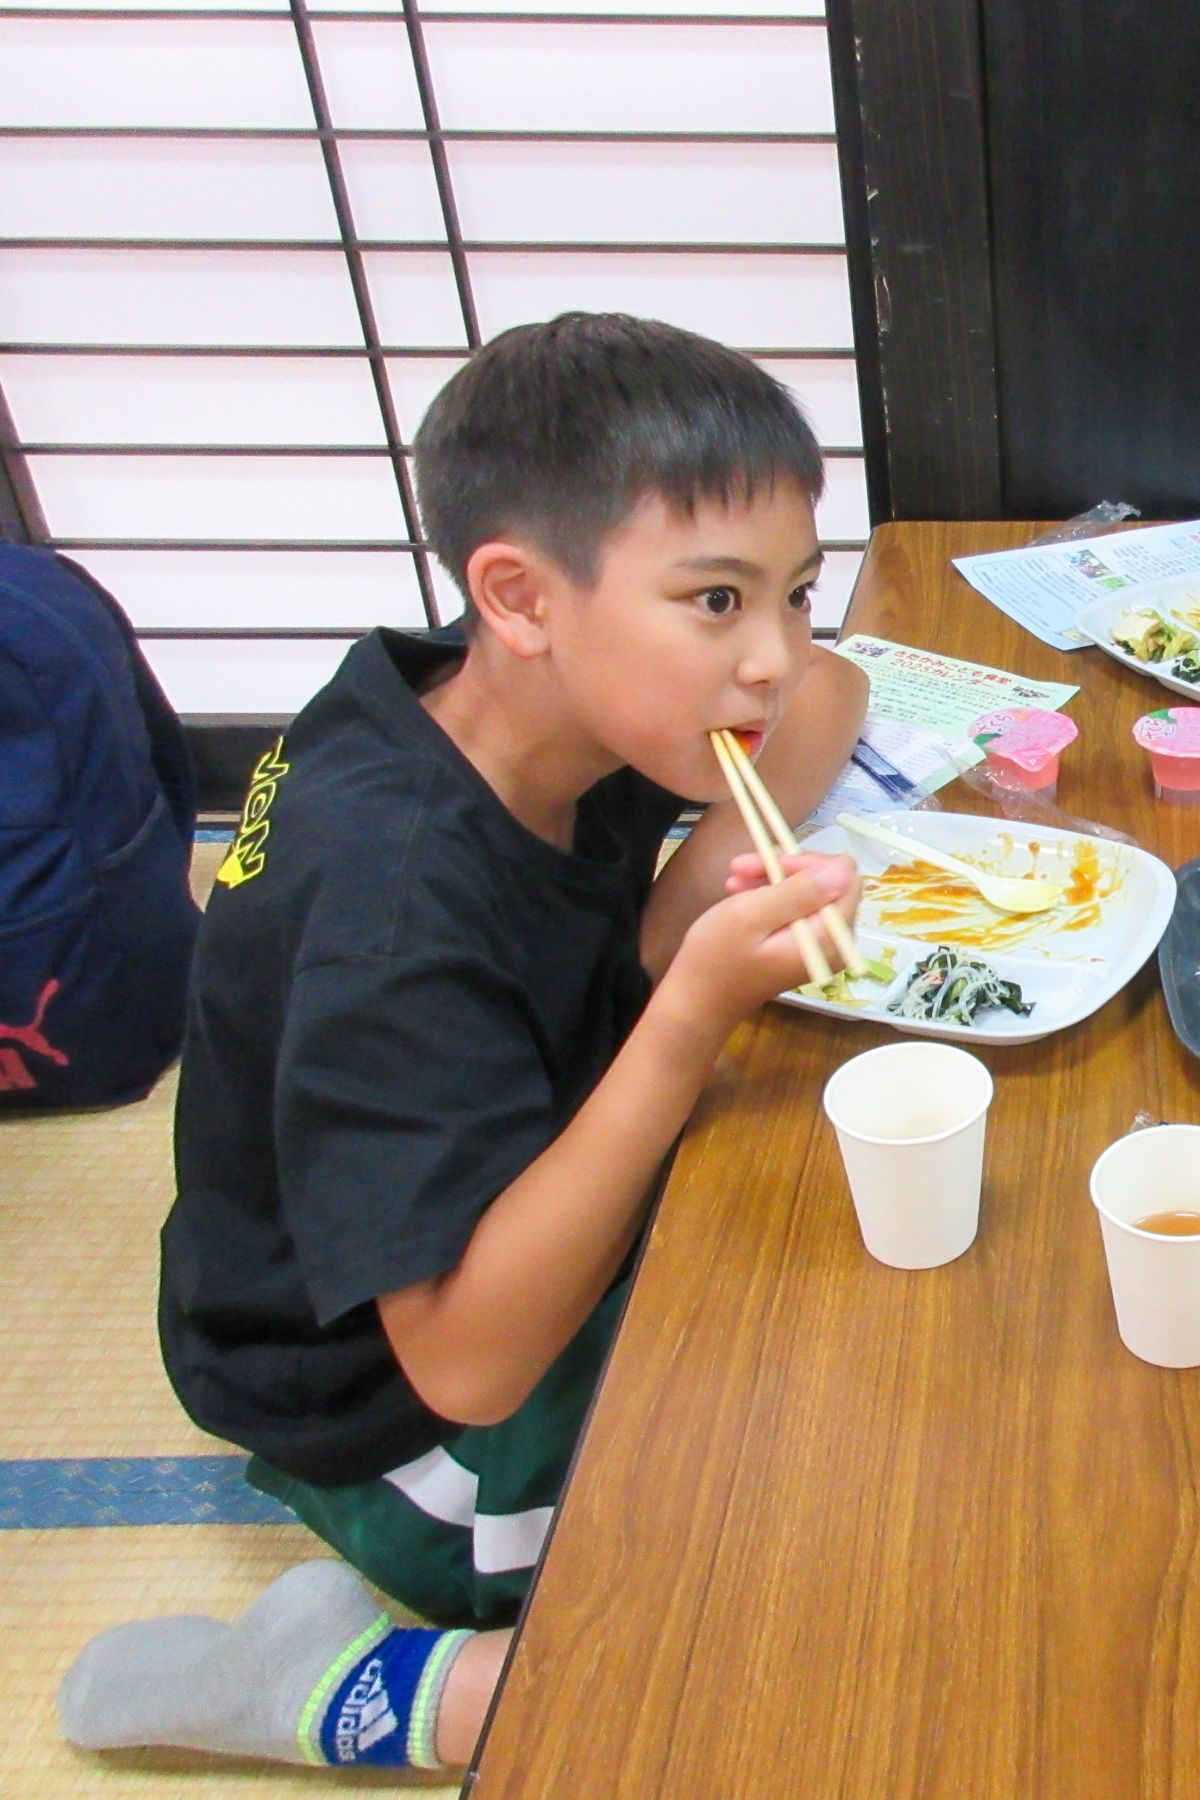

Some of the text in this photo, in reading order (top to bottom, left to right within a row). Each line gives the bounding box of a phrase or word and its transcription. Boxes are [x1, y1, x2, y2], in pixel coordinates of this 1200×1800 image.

[890, 658, 994, 688] 2025カレンダー
[335, 1658, 384, 1762] adidas
